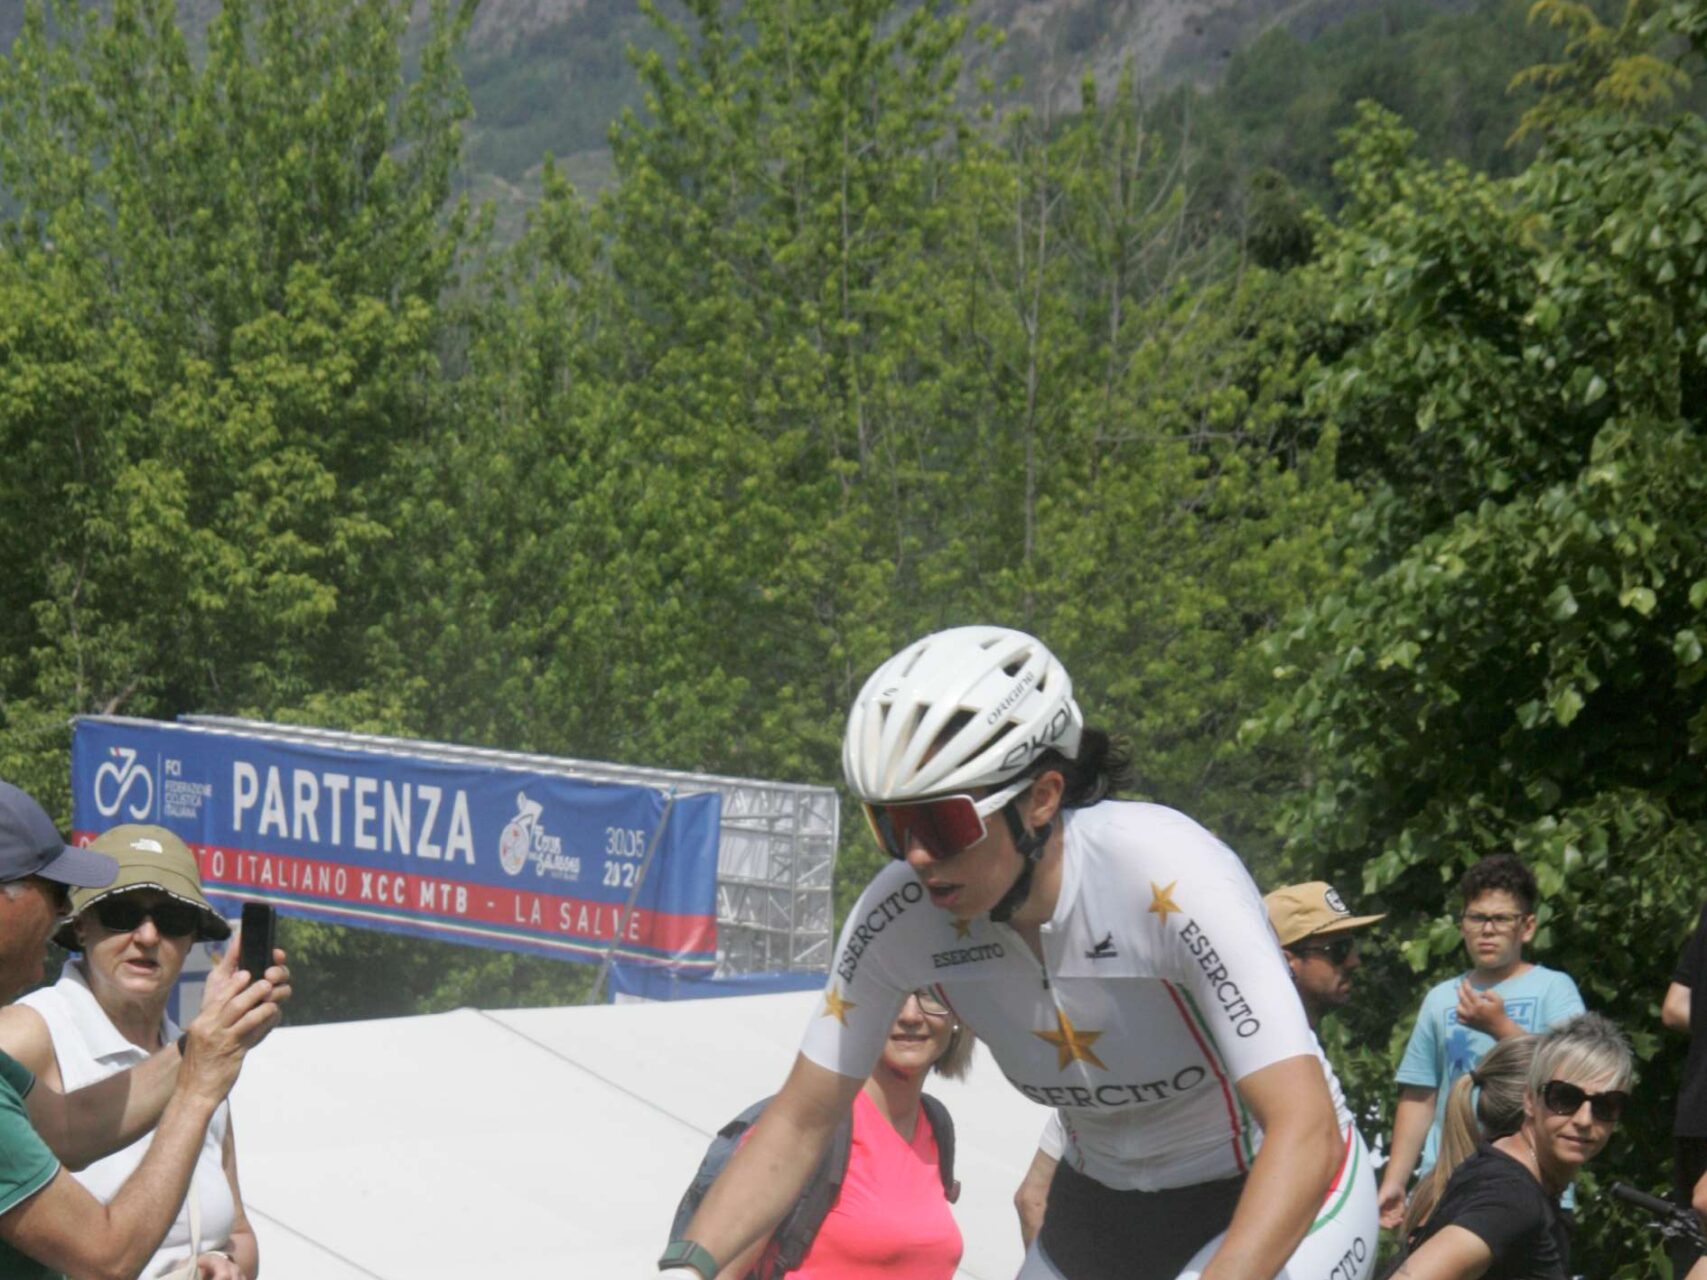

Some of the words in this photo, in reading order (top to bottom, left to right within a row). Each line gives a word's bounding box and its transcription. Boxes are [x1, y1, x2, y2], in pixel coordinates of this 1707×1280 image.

[232, 760, 475, 865] PARTENZA
[237, 853, 347, 896] ITALIANO
[360, 873, 405, 904] XCC
[420, 880, 468, 912] MTB
[515, 894, 542, 925] LA
[837, 881, 923, 983] ESERCITO
[933, 942, 1005, 969] ESERCITO
[1180, 919, 1261, 1039] ESERCITO
[1010, 1066, 1206, 1108] SERCITO
